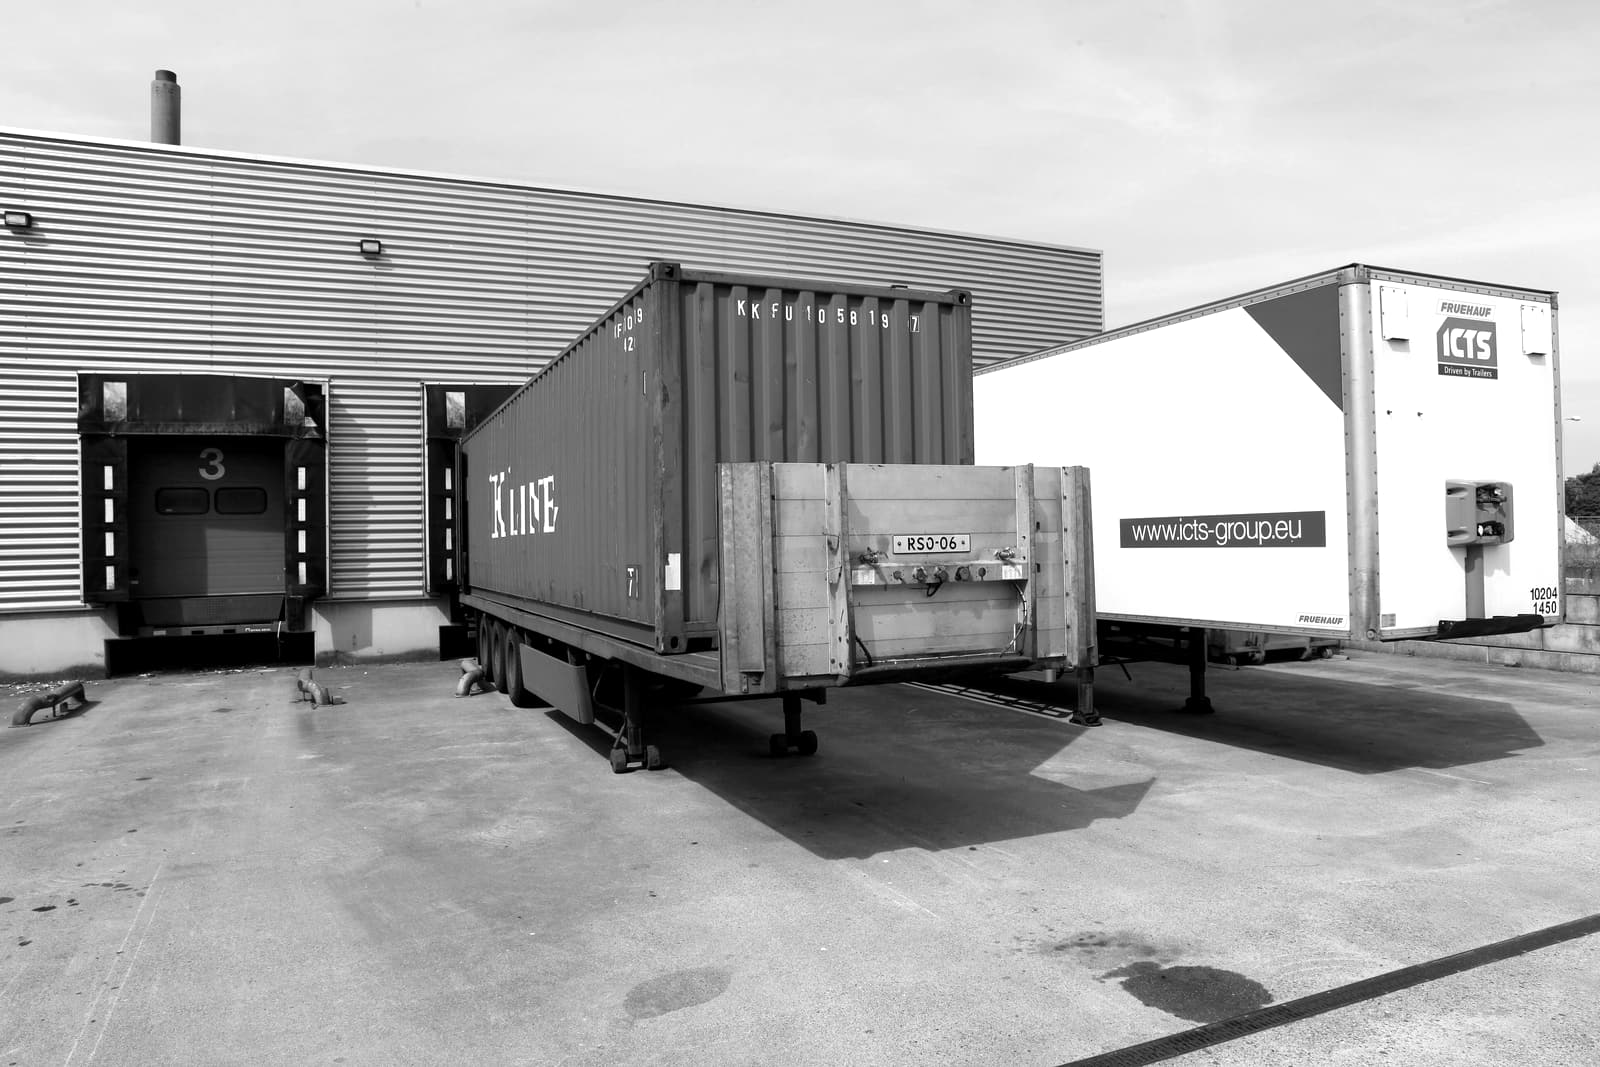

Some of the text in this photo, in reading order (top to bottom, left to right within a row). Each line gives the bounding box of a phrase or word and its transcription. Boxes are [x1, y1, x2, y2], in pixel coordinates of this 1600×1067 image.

[1440, 301, 1492, 317] FRUEHAUF
[1442, 327, 1492, 360] ICTS
[1444, 366, 1493, 378] Driven by Trailers
[199, 447, 226, 481] 3
[1132, 518, 1302, 546] www.icts-group.eu
[1530, 586, 1557, 601] 10204
[1533, 600, 1557, 615] 1450
[1298, 615, 1344, 625] FRUEHAUF
